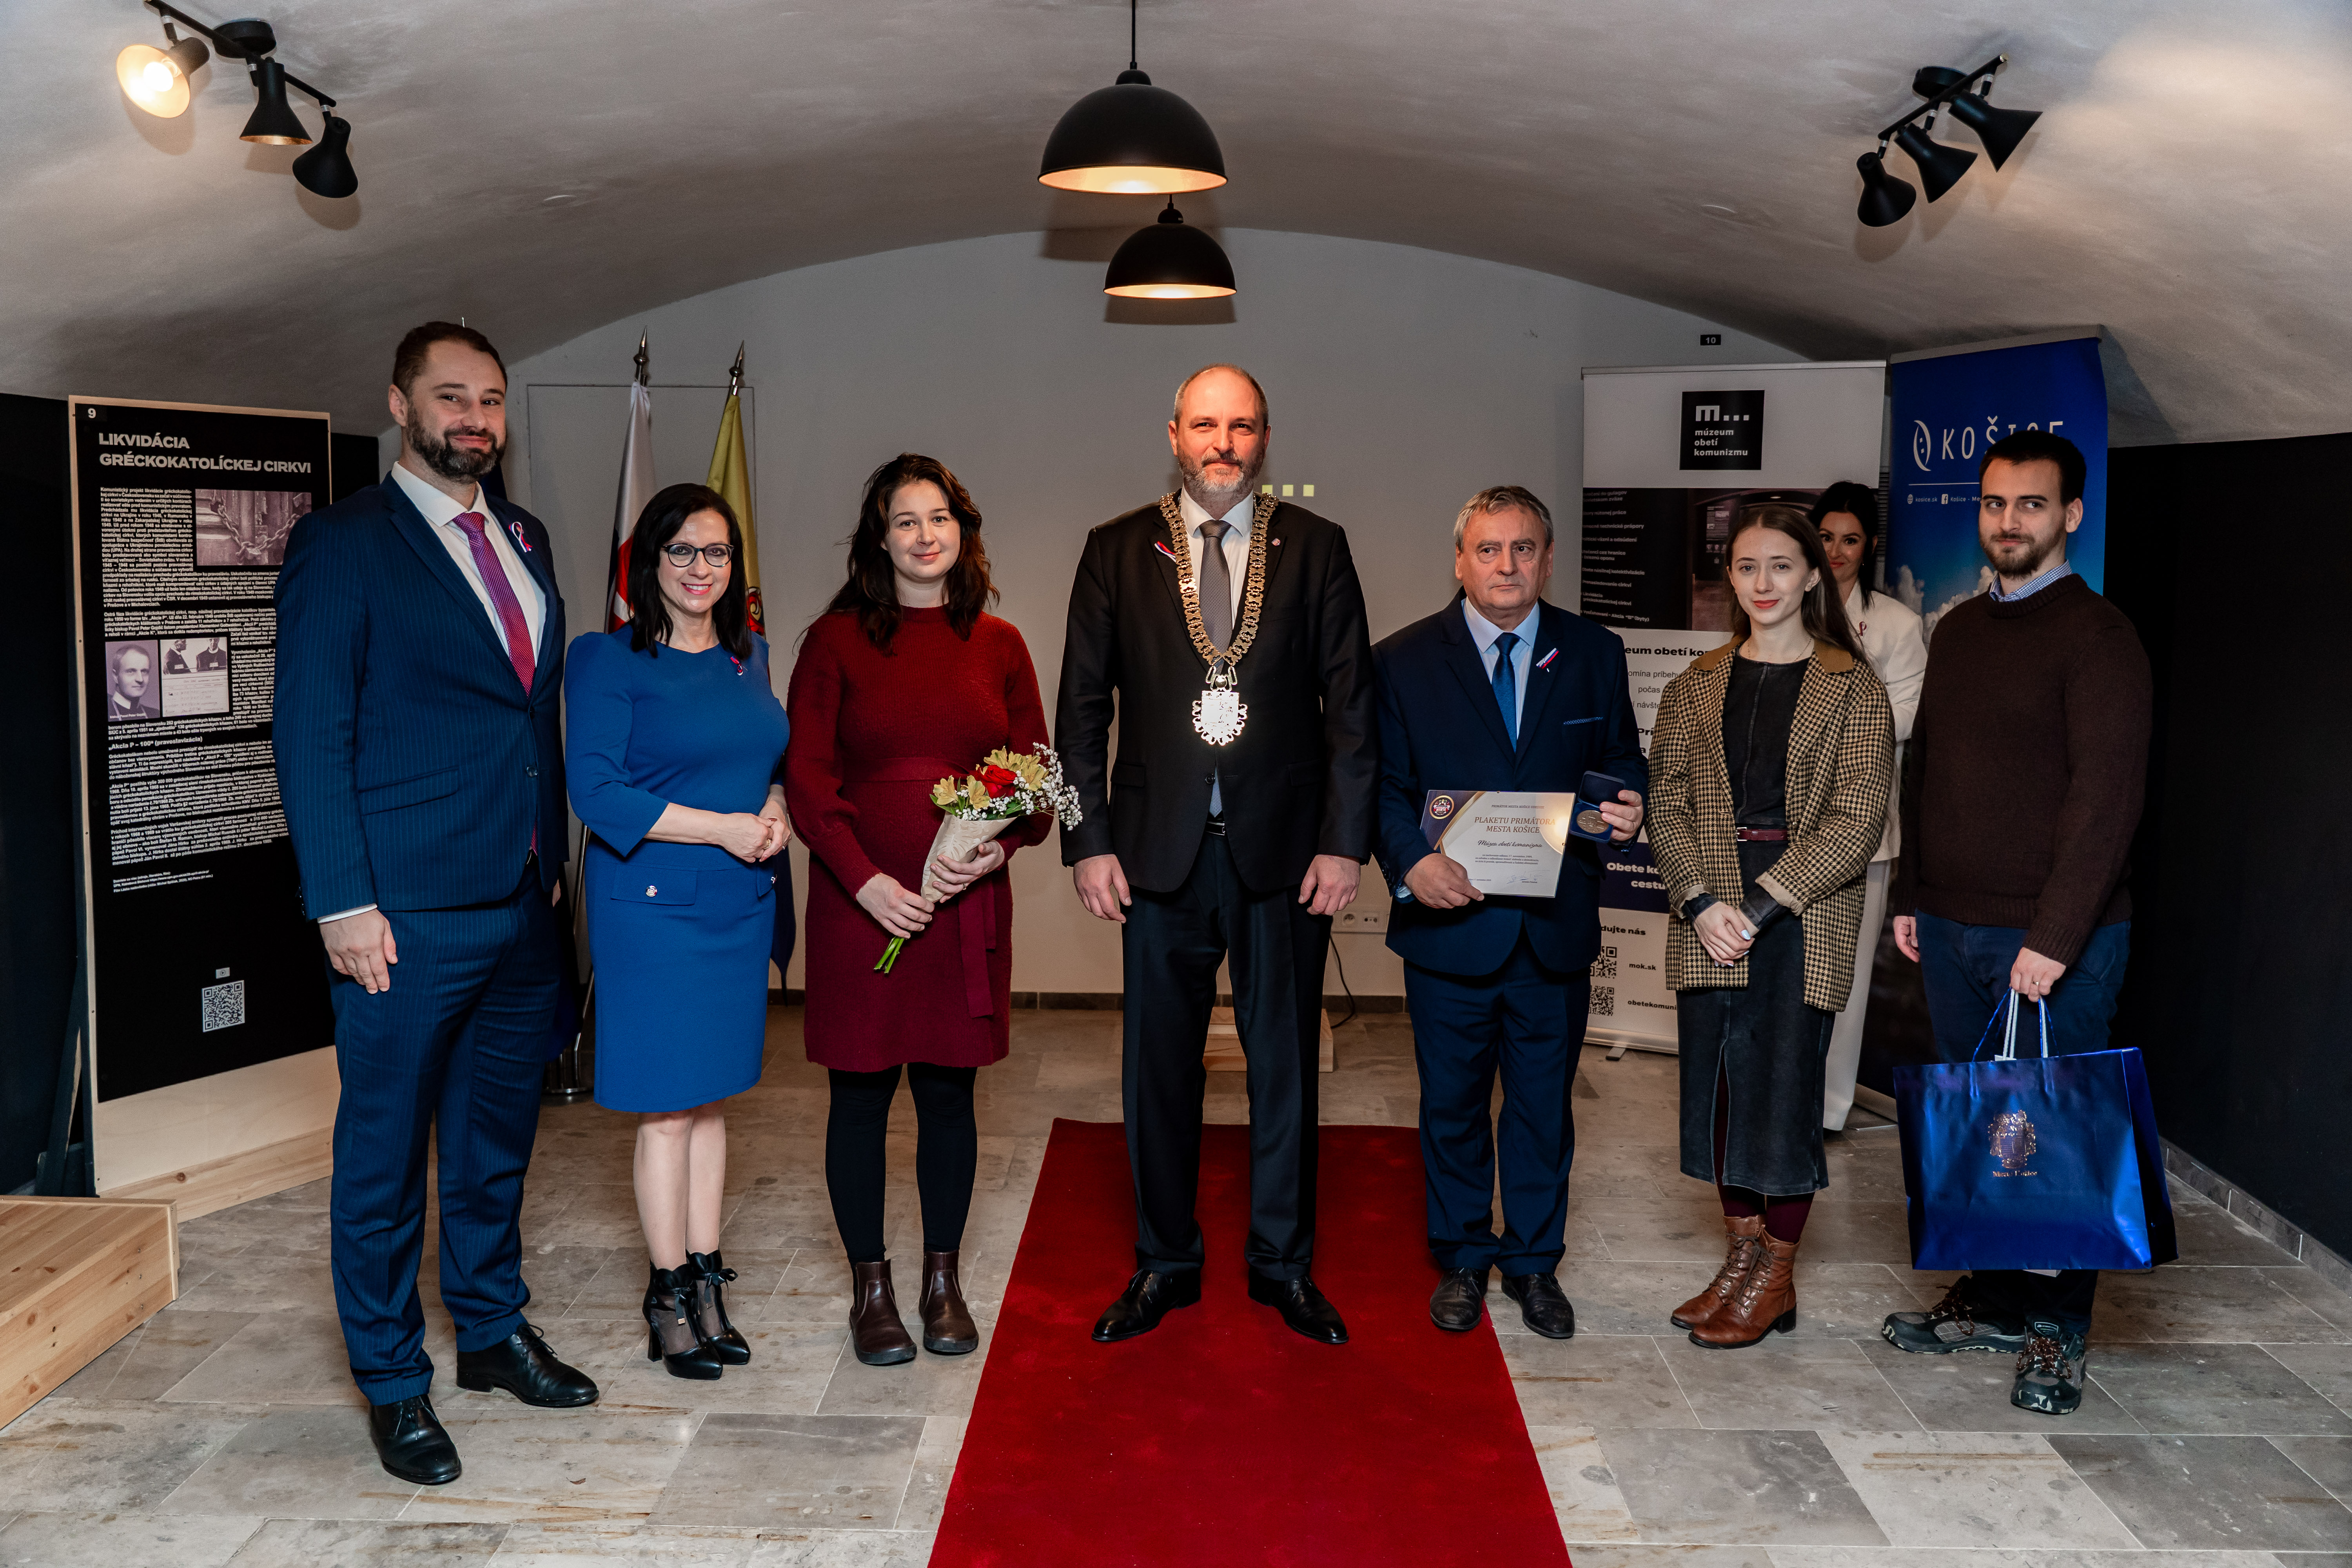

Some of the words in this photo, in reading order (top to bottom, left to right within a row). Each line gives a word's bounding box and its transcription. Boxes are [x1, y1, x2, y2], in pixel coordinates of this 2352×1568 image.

[88, 408, 96, 419] 9
[99, 432, 190, 448] LIKVIDÁCIA
[1942, 416, 2063, 459] KOŠ
[100, 451, 261, 472] GRÉCKOKATOLÍCKEJ
[263, 461, 311, 473] CIRKVI
[1654, 647, 1688, 656] obetí
[155, 736, 203, 746] (pravoslavizácia)
[1510, 817, 1555, 825] PRIMÁTORA
[1513, 825, 1540, 833] KOŠICE
[1606, 862, 1644, 873] Obete
[1631, 880, 1666, 890] cestu
[1629, 962, 1656, 971] mok.sk
